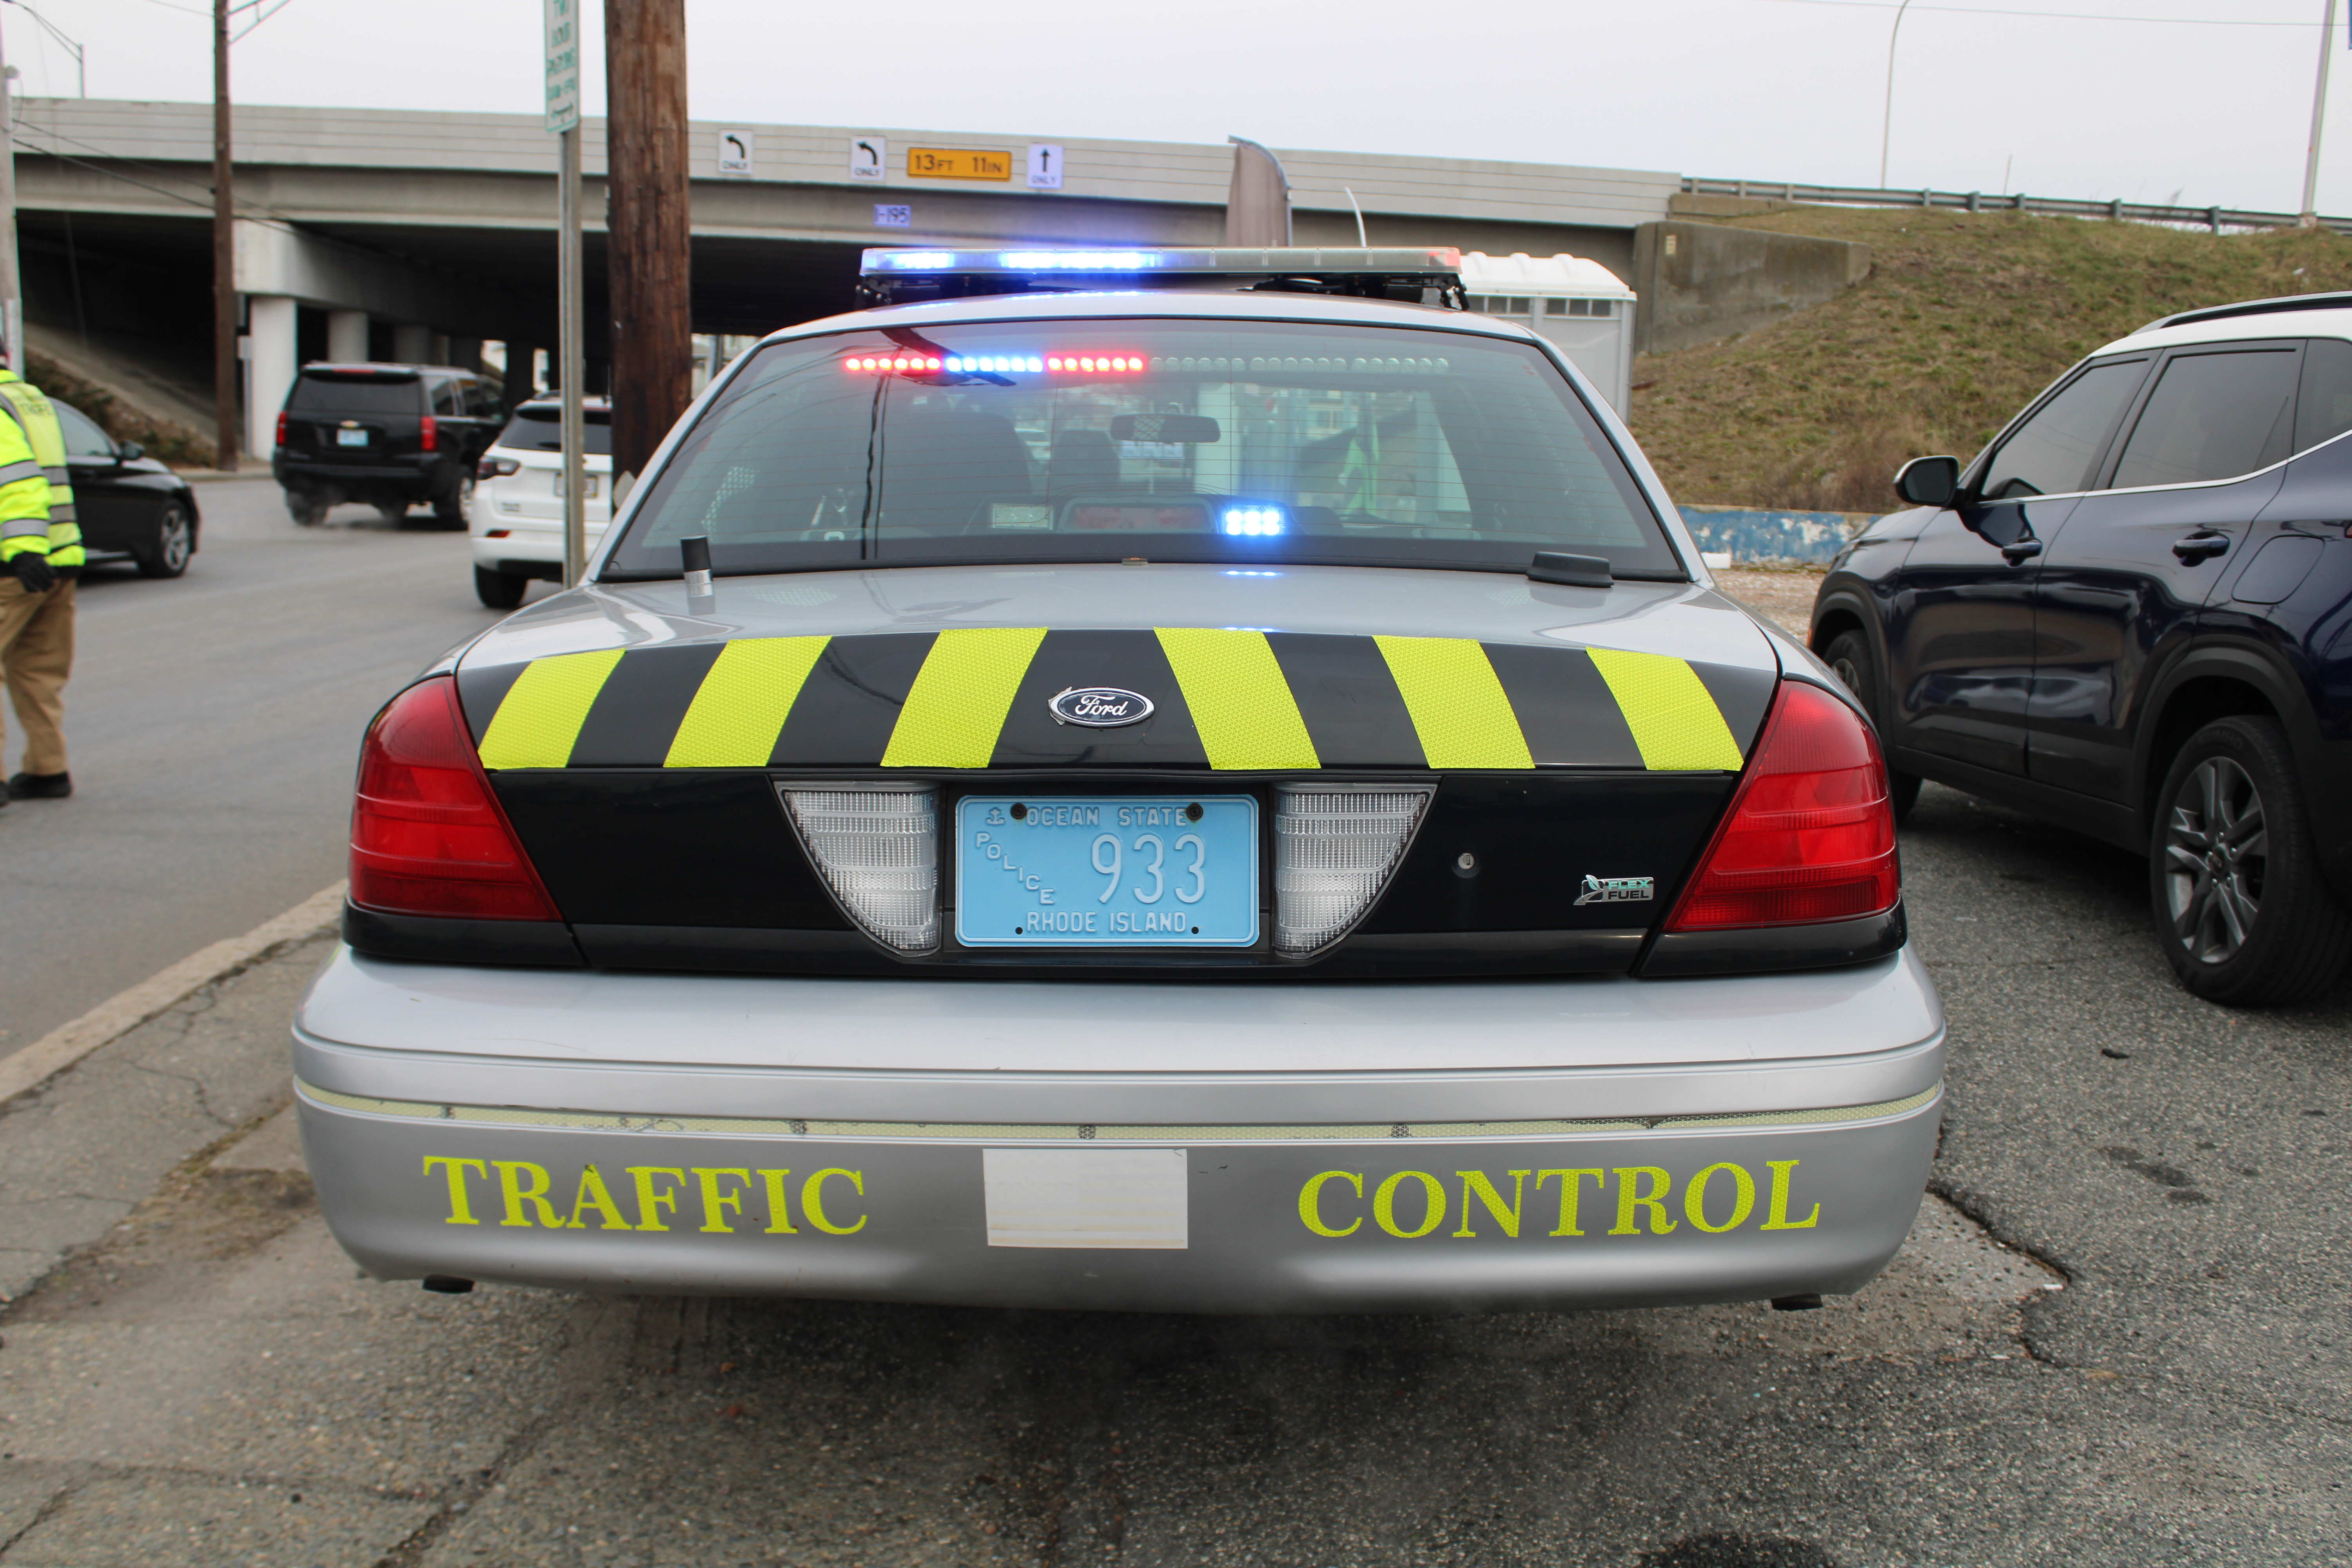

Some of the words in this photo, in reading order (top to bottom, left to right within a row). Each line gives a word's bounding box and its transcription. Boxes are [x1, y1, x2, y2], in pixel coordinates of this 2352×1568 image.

[722, 161, 747, 169] ONLY
[855, 167, 880, 176] ONLY
[1031, 175, 1057, 184] ONLY
[1075, 695, 1129, 716] Ford
[1026, 806, 1100, 826] OCEAN
[1118, 807, 1187, 827] STATE
[976, 832, 1055, 905] POLICE
[1092, 834, 1205, 904] 933
[1608, 879, 1651, 890] FLEX
[1608, 890, 1649, 900] FUEL
[1027, 911, 1097, 933] RHODE
[1110, 911, 1187, 933] ISLAND
[423, 1156, 867, 1235] TRAFFIC
[1298, 1159, 1821, 1238] CONTROL
